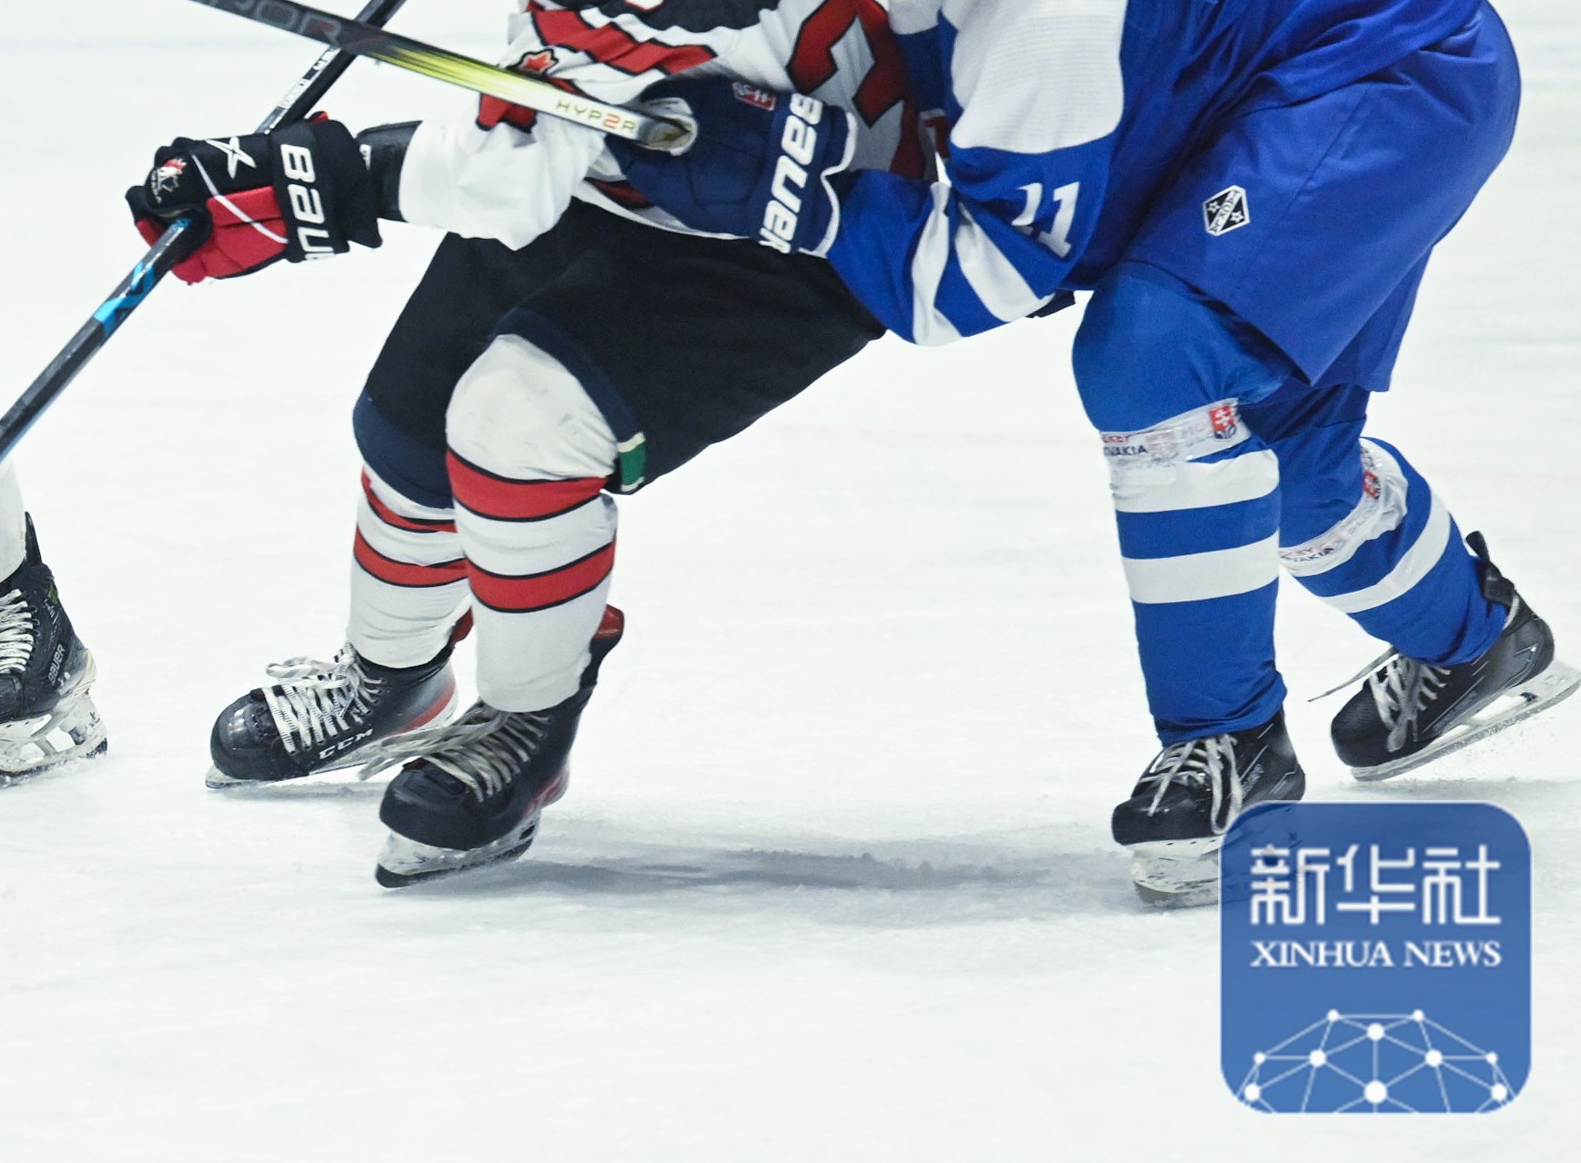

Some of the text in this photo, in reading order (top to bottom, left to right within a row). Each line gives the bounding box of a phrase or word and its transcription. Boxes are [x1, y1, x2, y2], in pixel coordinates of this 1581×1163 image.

[280, 143, 338, 262] BAU
[48, 643, 66, 685] BAUER
[318, 728, 374, 760] CCM
